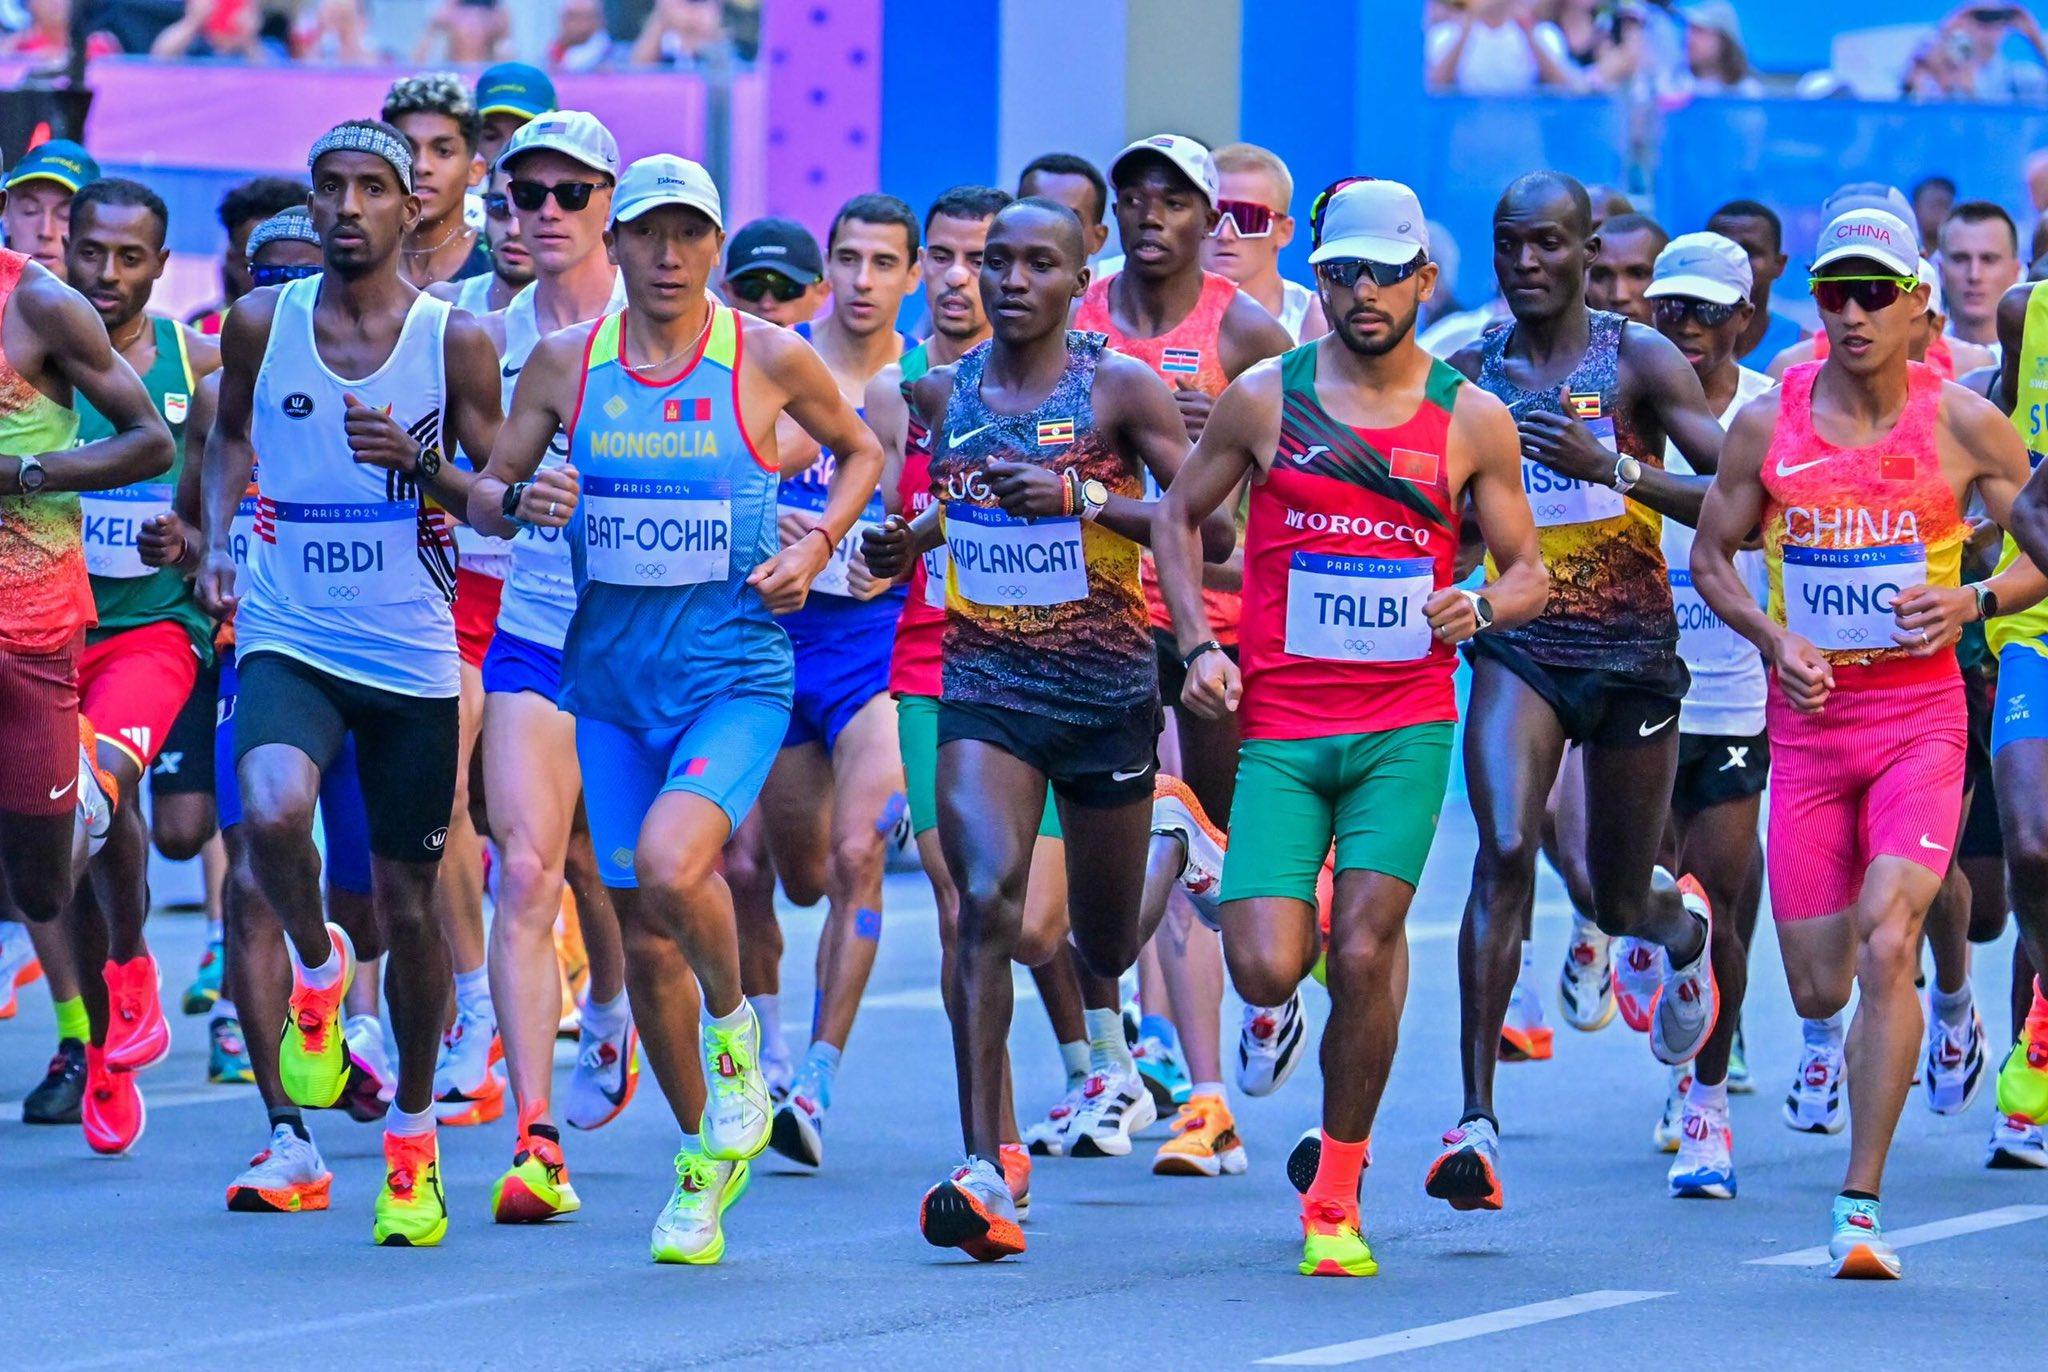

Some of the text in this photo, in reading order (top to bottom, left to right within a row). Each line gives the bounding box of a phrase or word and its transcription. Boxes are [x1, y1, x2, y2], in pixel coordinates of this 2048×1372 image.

[1836, 224, 1891, 246] CHINA
[590, 430, 719, 459] MONGOLIA
[614, 483, 690, 494] PARIS 2024
[1522, 462, 1595, 494] ISS
[303, 508, 379, 518] PARIS 2024
[972, 510, 1001, 522] PARIS
[1284, 508, 1431, 546] MOROCCO
[1784, 506, 1920, 545] CHINA
[587, 513, 728, 552] BAT-OCHIR
[303, 540, 384, 573] ABDI
[948, 536, 1080, 574] KIPLANGAT
[1327, 560, 1402, 574] PARIS 2024
[1813, 553, 1887, 563] PARIS 2024
[1314, 592, 1409, 628] TALBI
